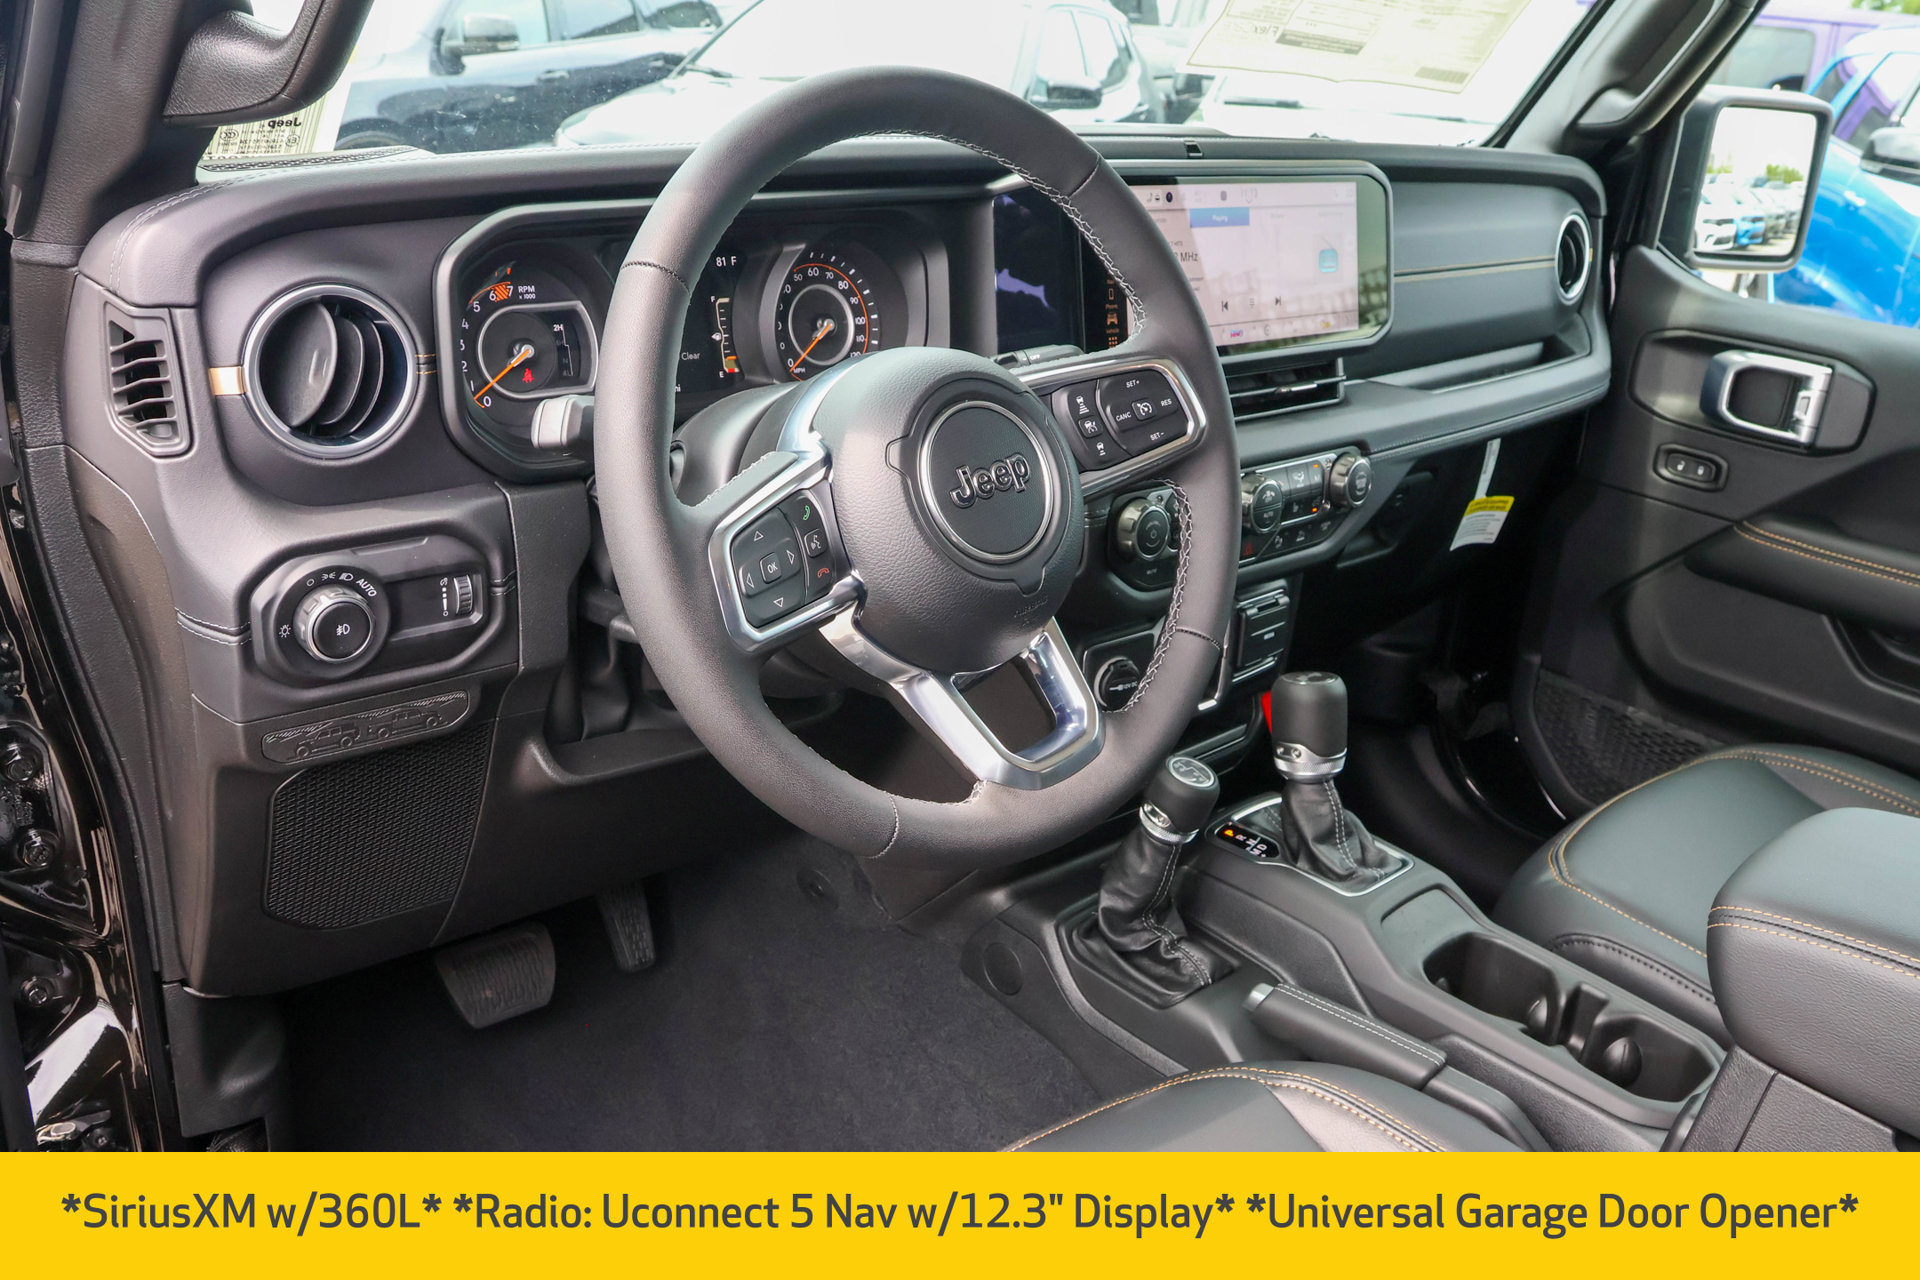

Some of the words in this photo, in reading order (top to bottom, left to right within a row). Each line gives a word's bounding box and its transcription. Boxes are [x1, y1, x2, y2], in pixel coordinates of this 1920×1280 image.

[716, 256, 726, 267] 81
[731, 255, 737, 266] F
[1180, 252, 1198, 262] MHz
[793, 273, 803, 281] 50
[807, 267, 820, 277] 60
[825, 271, 834, 279] 70
[517, 285, 535, 294] RPM
[838, 280, 849, 290] 80
[489, 290, 497, 301] 6
[506, 285, 514, 297] 7
[850, 296, 859, 304] 90
[473, 301, 480, 312] 5
[461, 318, 469, 329] 4
[855, 316, 866, 325] 100
[856, 334, 865, 342] 110
[681, 352, 700, 361] Clear
[461, 360, 468, 372] 2
[787, 358, 794, 368] 0
[483, 396, 491, 407] 0
[1161, 398, 1172, 407] RES
[1115, 411, 1132, 422] CANC
[949, 452, 1031, 509] Jeep
[767, 562, 778, 574] OK
[355, 578, 377, 598] AUTO
